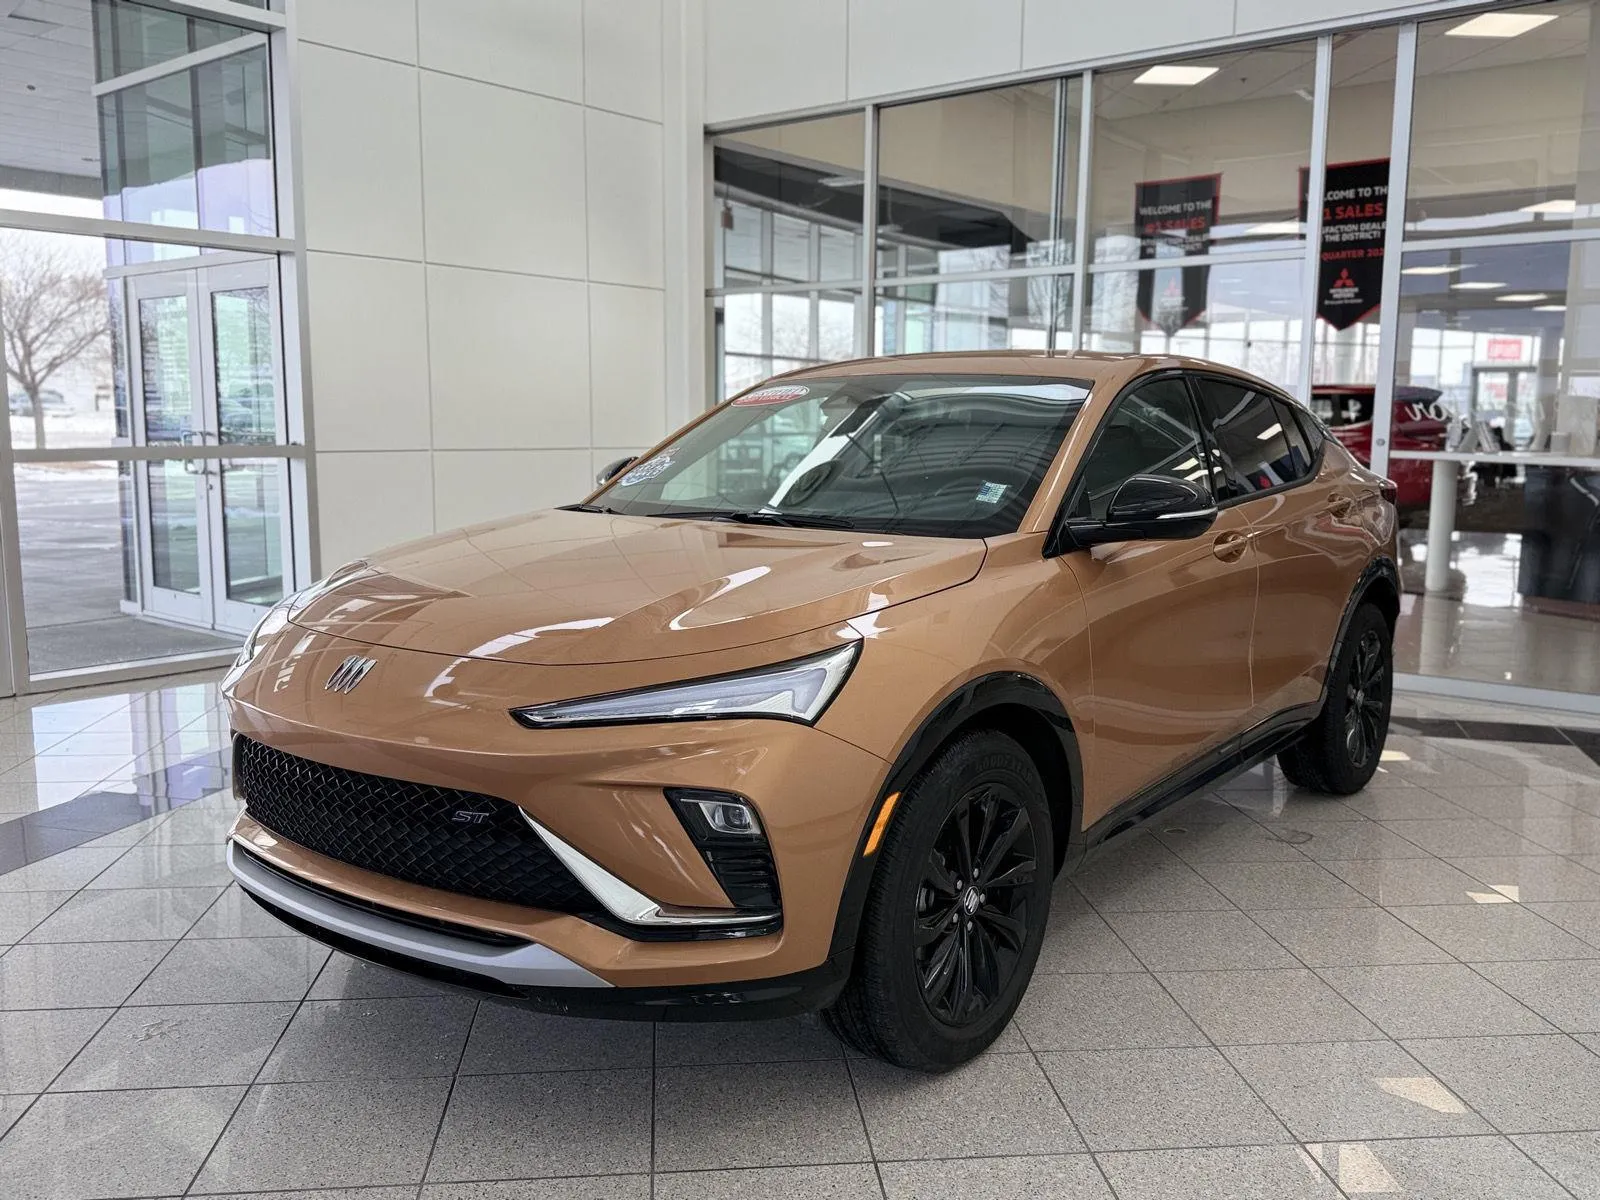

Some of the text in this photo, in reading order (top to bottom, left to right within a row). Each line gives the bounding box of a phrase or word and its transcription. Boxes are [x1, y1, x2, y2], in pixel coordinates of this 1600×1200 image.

[1323, 185, 1388, 201] COME TO TH
[1139, 199, 1212, 216] WELCOME TO THE
[1323, 203, 1384, 220] 1 SALES
[1360, 221, 1387, 230] DEALE
[1325, 231, 1381, 242] THE DISTRICT!
[1322, 248, 1384, 260] QUARTER 202
[451, 810, 490, 824] ST
